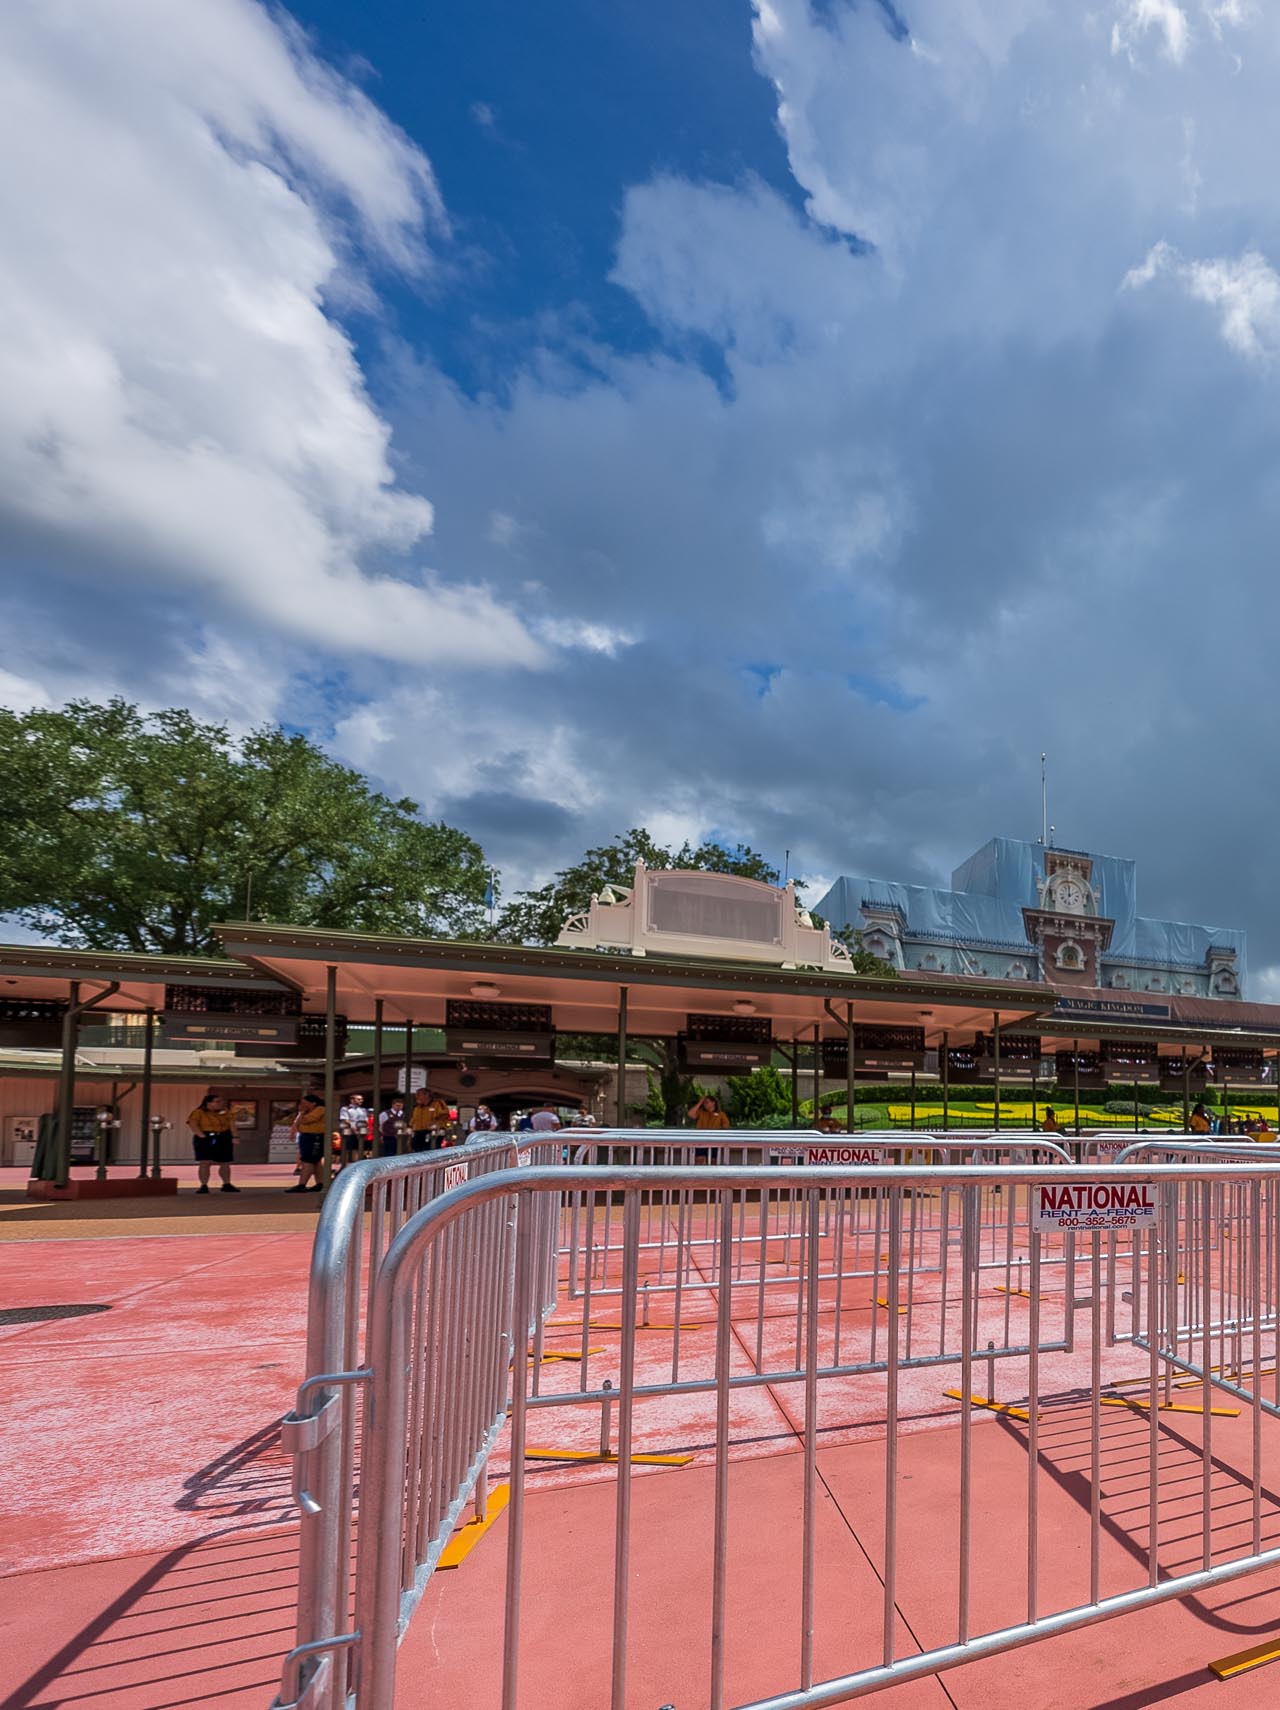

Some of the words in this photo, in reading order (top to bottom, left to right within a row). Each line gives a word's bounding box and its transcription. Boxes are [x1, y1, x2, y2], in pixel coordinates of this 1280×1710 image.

[1067, 1000, 1098, 1010] MAGIC
[1101, 1002, 1144, 1014] KINGDOM
[808, 1149, 879, 1162] NATIONAL
[1041, 1186, 1154, 1209] NATIONAL
[1040, 1208, 1153, 1218] RENT-A-FENCE
[1058, 1216, 1137, 1226] 800-352-5675
